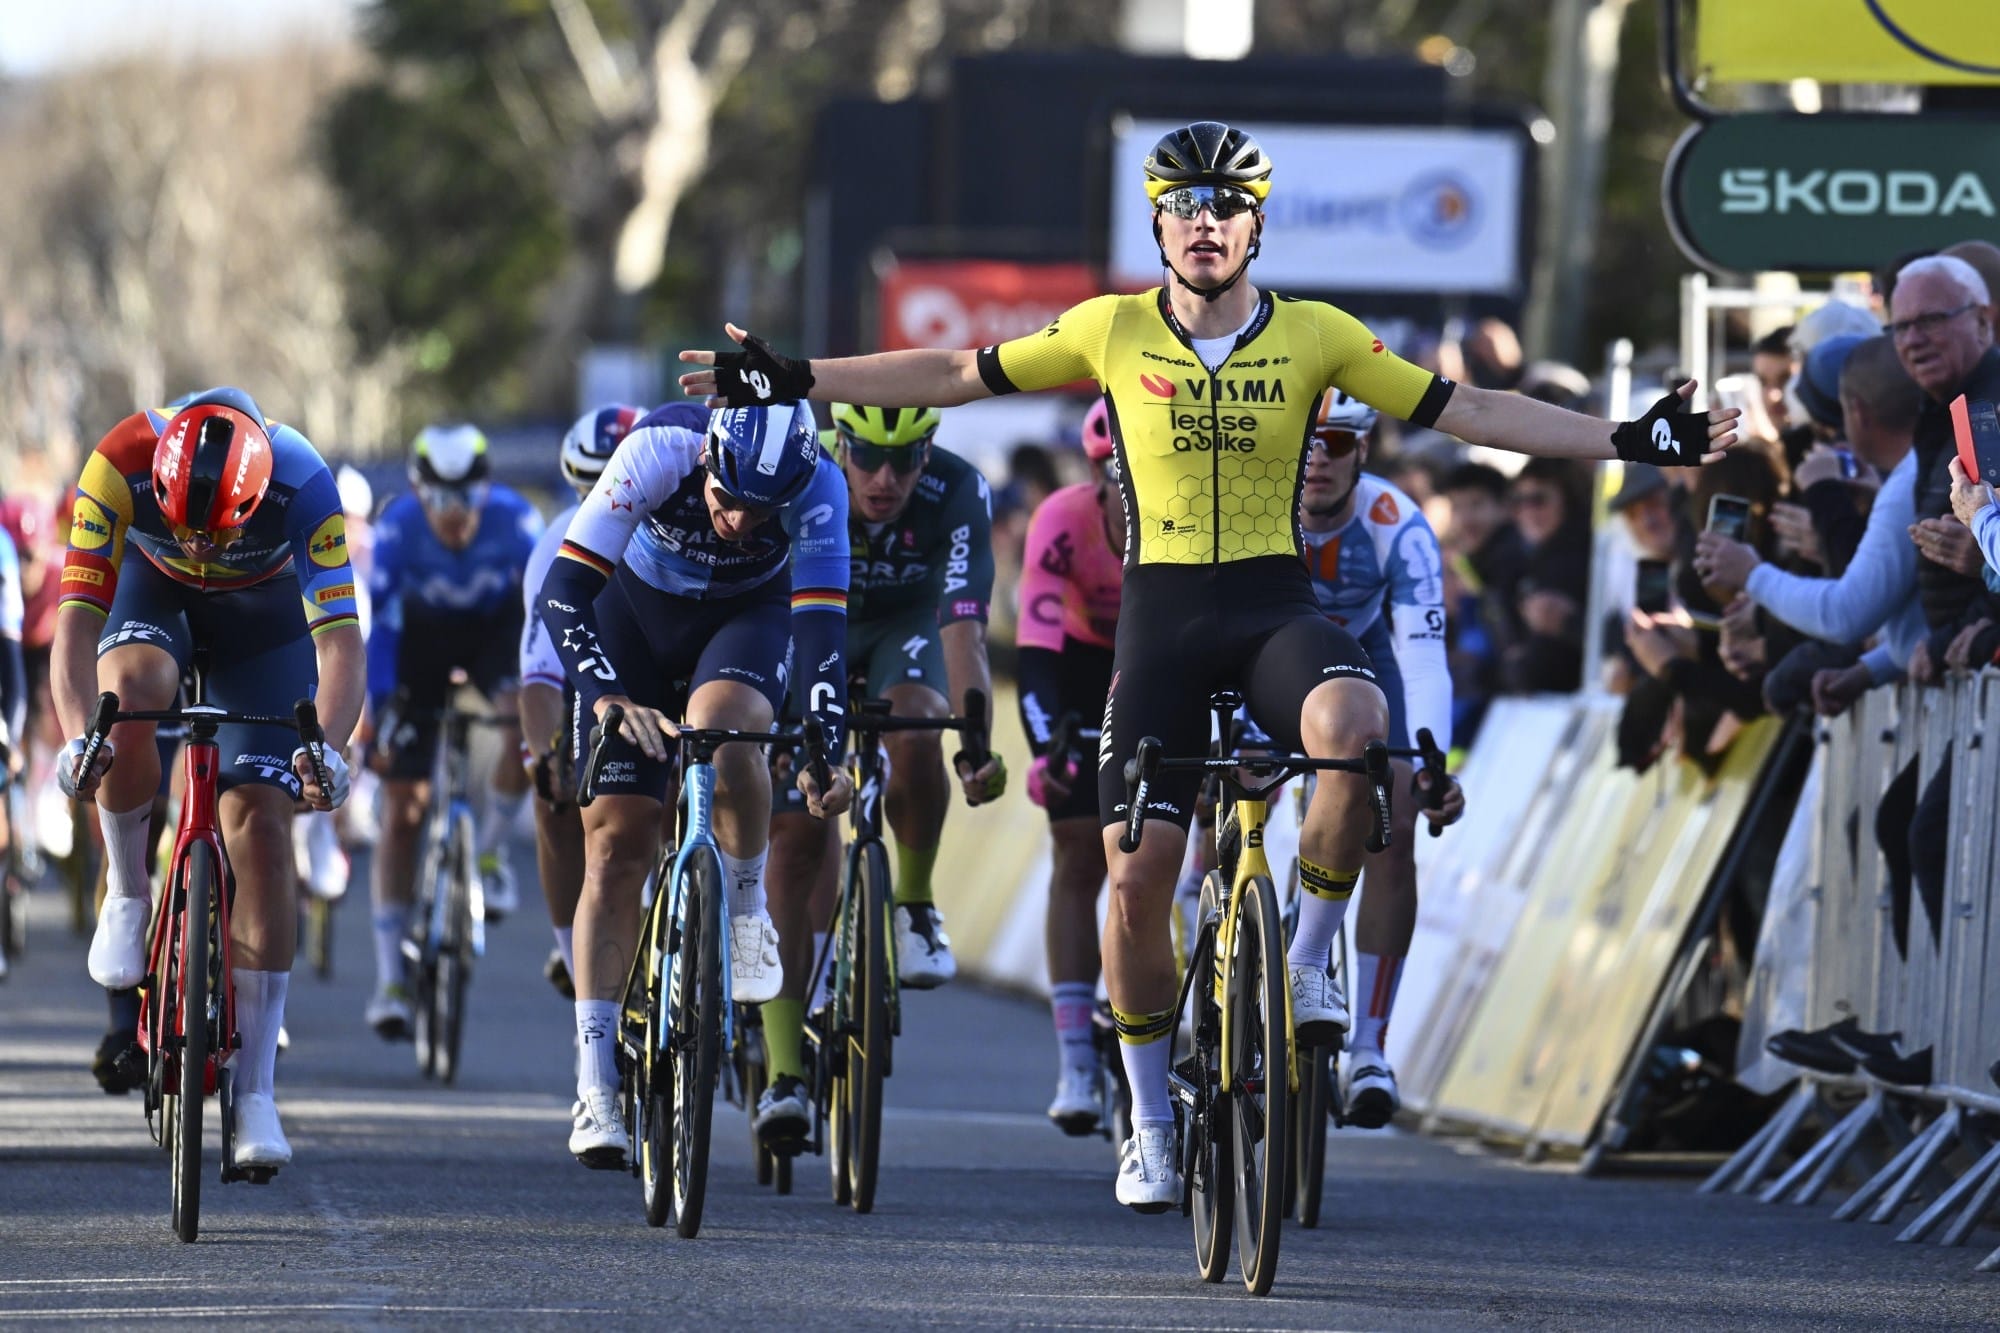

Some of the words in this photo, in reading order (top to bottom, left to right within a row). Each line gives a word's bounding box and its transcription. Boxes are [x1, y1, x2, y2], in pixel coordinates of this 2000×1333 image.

[1141, 350, 1196, 369] cervélo
[1185, 378, 1286, 403] VISMA
[1170, 409, 1257, 432] lease
[229, 431, 259, 497] TREK
[943, 525, 970, 595] BORA
[572, 691, 581, 760] PREMIER
[598, 773, 639, 783] HANGE
[696, 773, 709, 837] FACTOR
[1180, 1088, 1195, 1106] SRA
